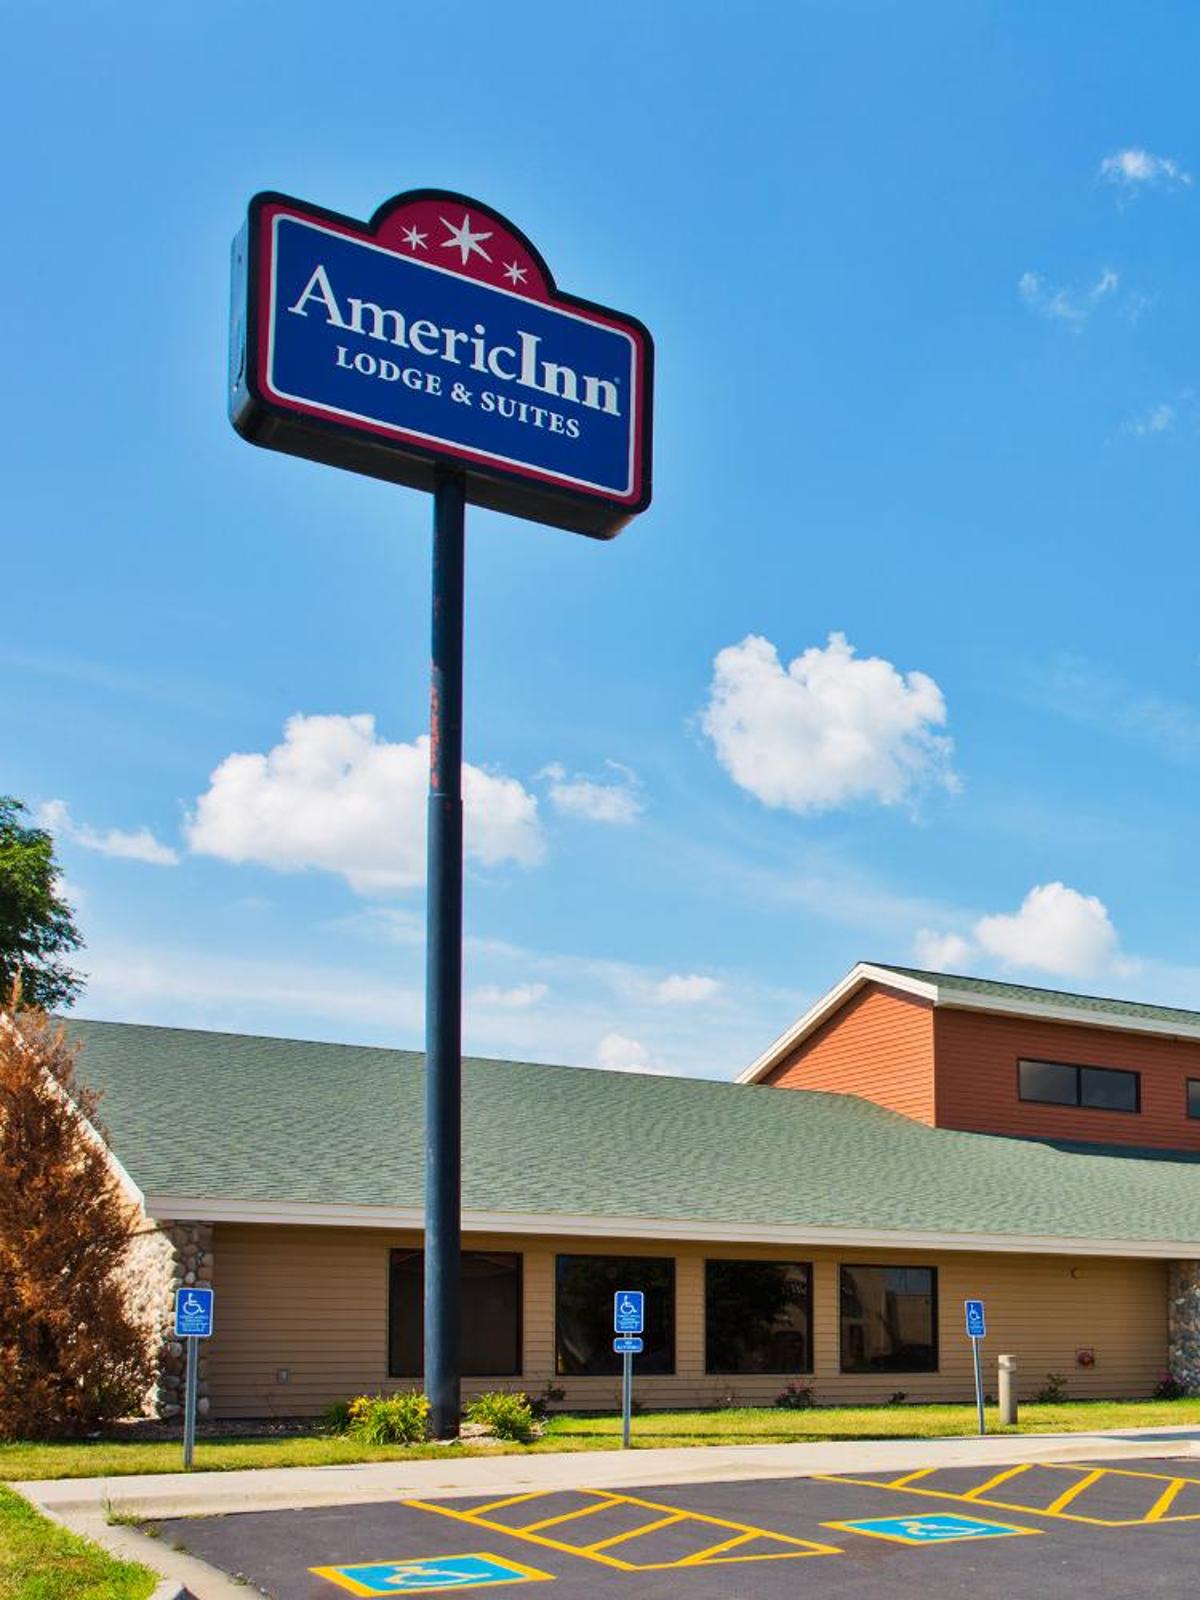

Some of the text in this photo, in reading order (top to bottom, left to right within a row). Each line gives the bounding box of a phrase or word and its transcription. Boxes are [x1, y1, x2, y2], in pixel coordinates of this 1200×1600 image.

[288, 265, 621, 417] AmericInn
[336, 346, 581, 438] LODGE & SUITES
